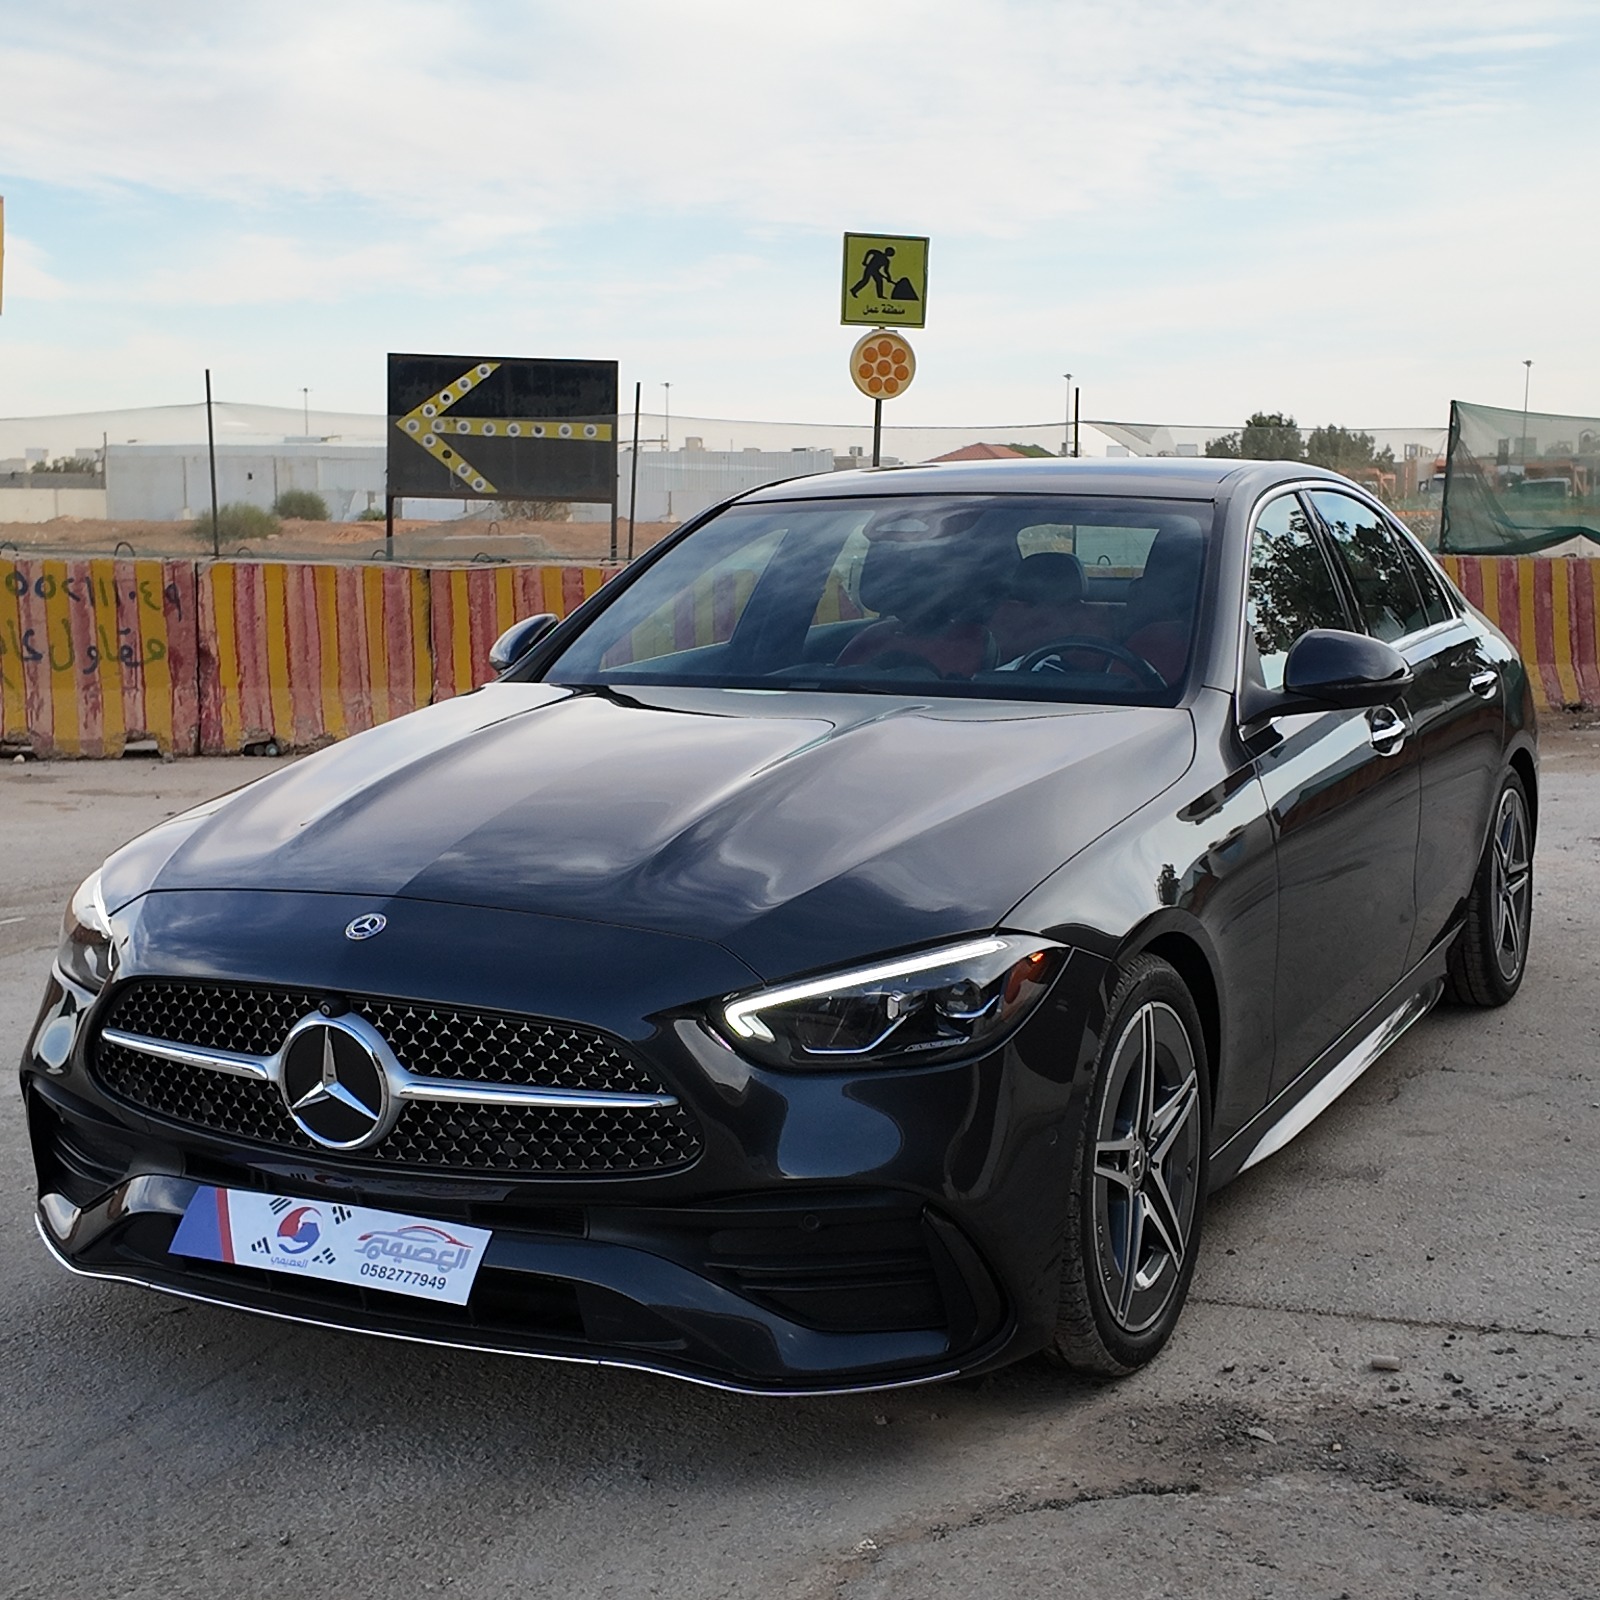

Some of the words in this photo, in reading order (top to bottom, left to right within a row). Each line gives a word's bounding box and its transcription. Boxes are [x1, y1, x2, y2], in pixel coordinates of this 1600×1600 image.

[51, 618, 167, 674] مقاول
[354, 1237, 471, 1274] العصيمي
[360, 1262, 447, 1291] 0582777949
